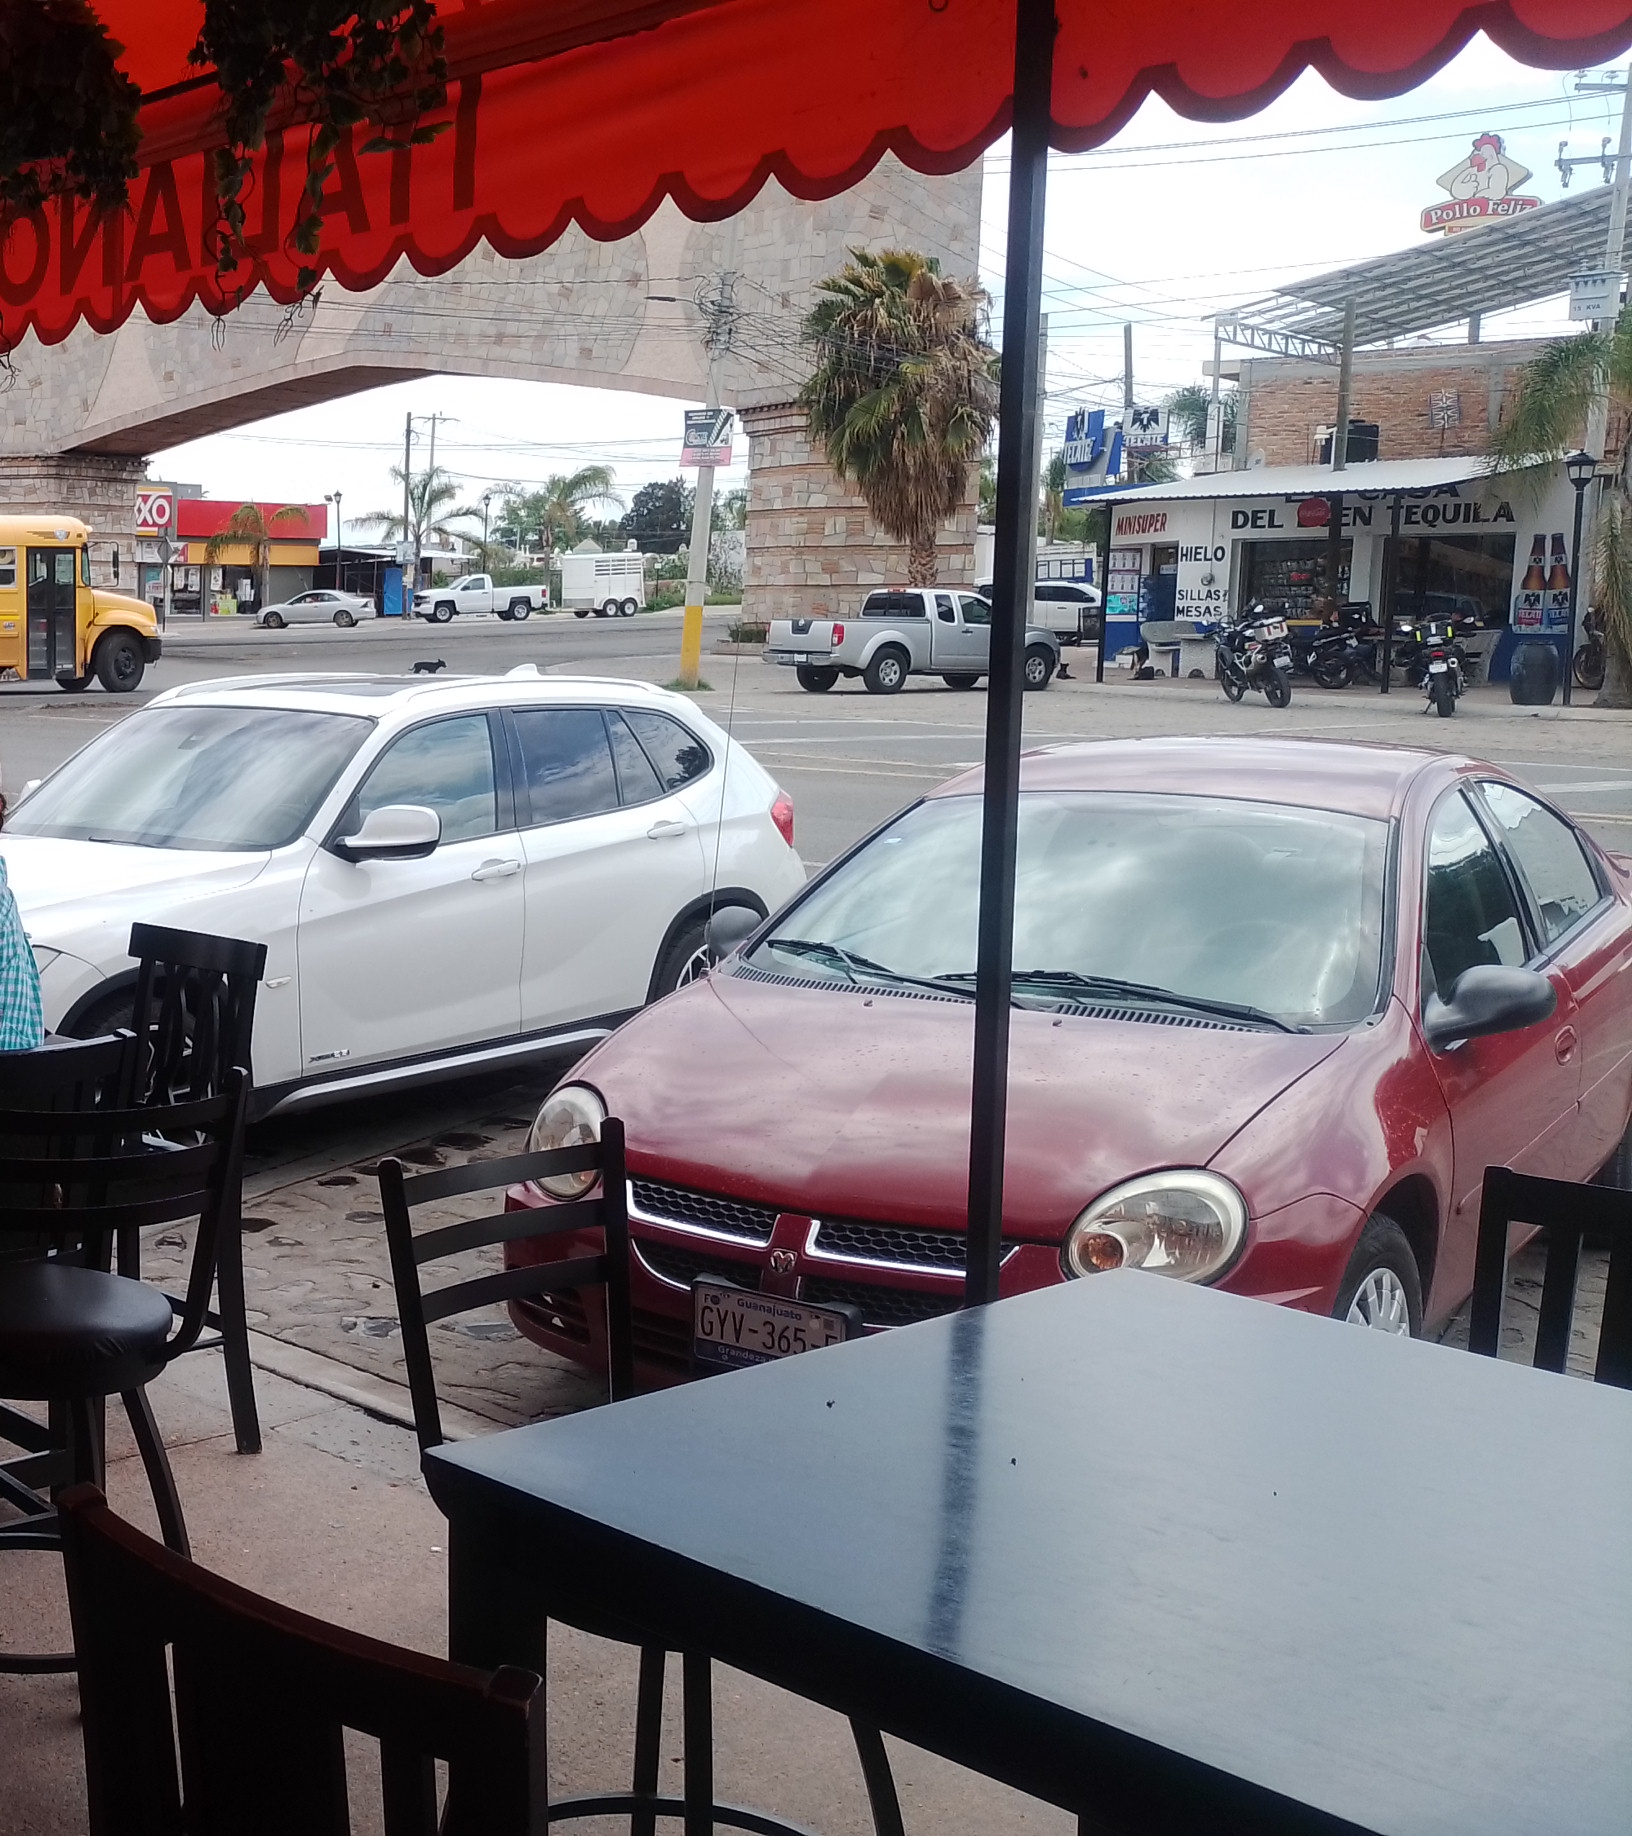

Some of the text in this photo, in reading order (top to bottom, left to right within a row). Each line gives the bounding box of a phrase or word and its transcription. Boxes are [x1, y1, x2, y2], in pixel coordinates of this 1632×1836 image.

[1429, 203, 1481, 224] Pollo
[1586, 303, 1601, 311] KVA
[1123, 434, 1165, 447] TECATE
[1115, 512, 1168, 537] MINISUPER
[1230, 509, 1284, 529] DEL
[1179, 545, 1226, 562] HIELO
[1177, 589, 1221, 601] SILLAS
[1175, 605, 1223, 618] MESAS
[736, 1297, 803, 1321] Guanajuato
